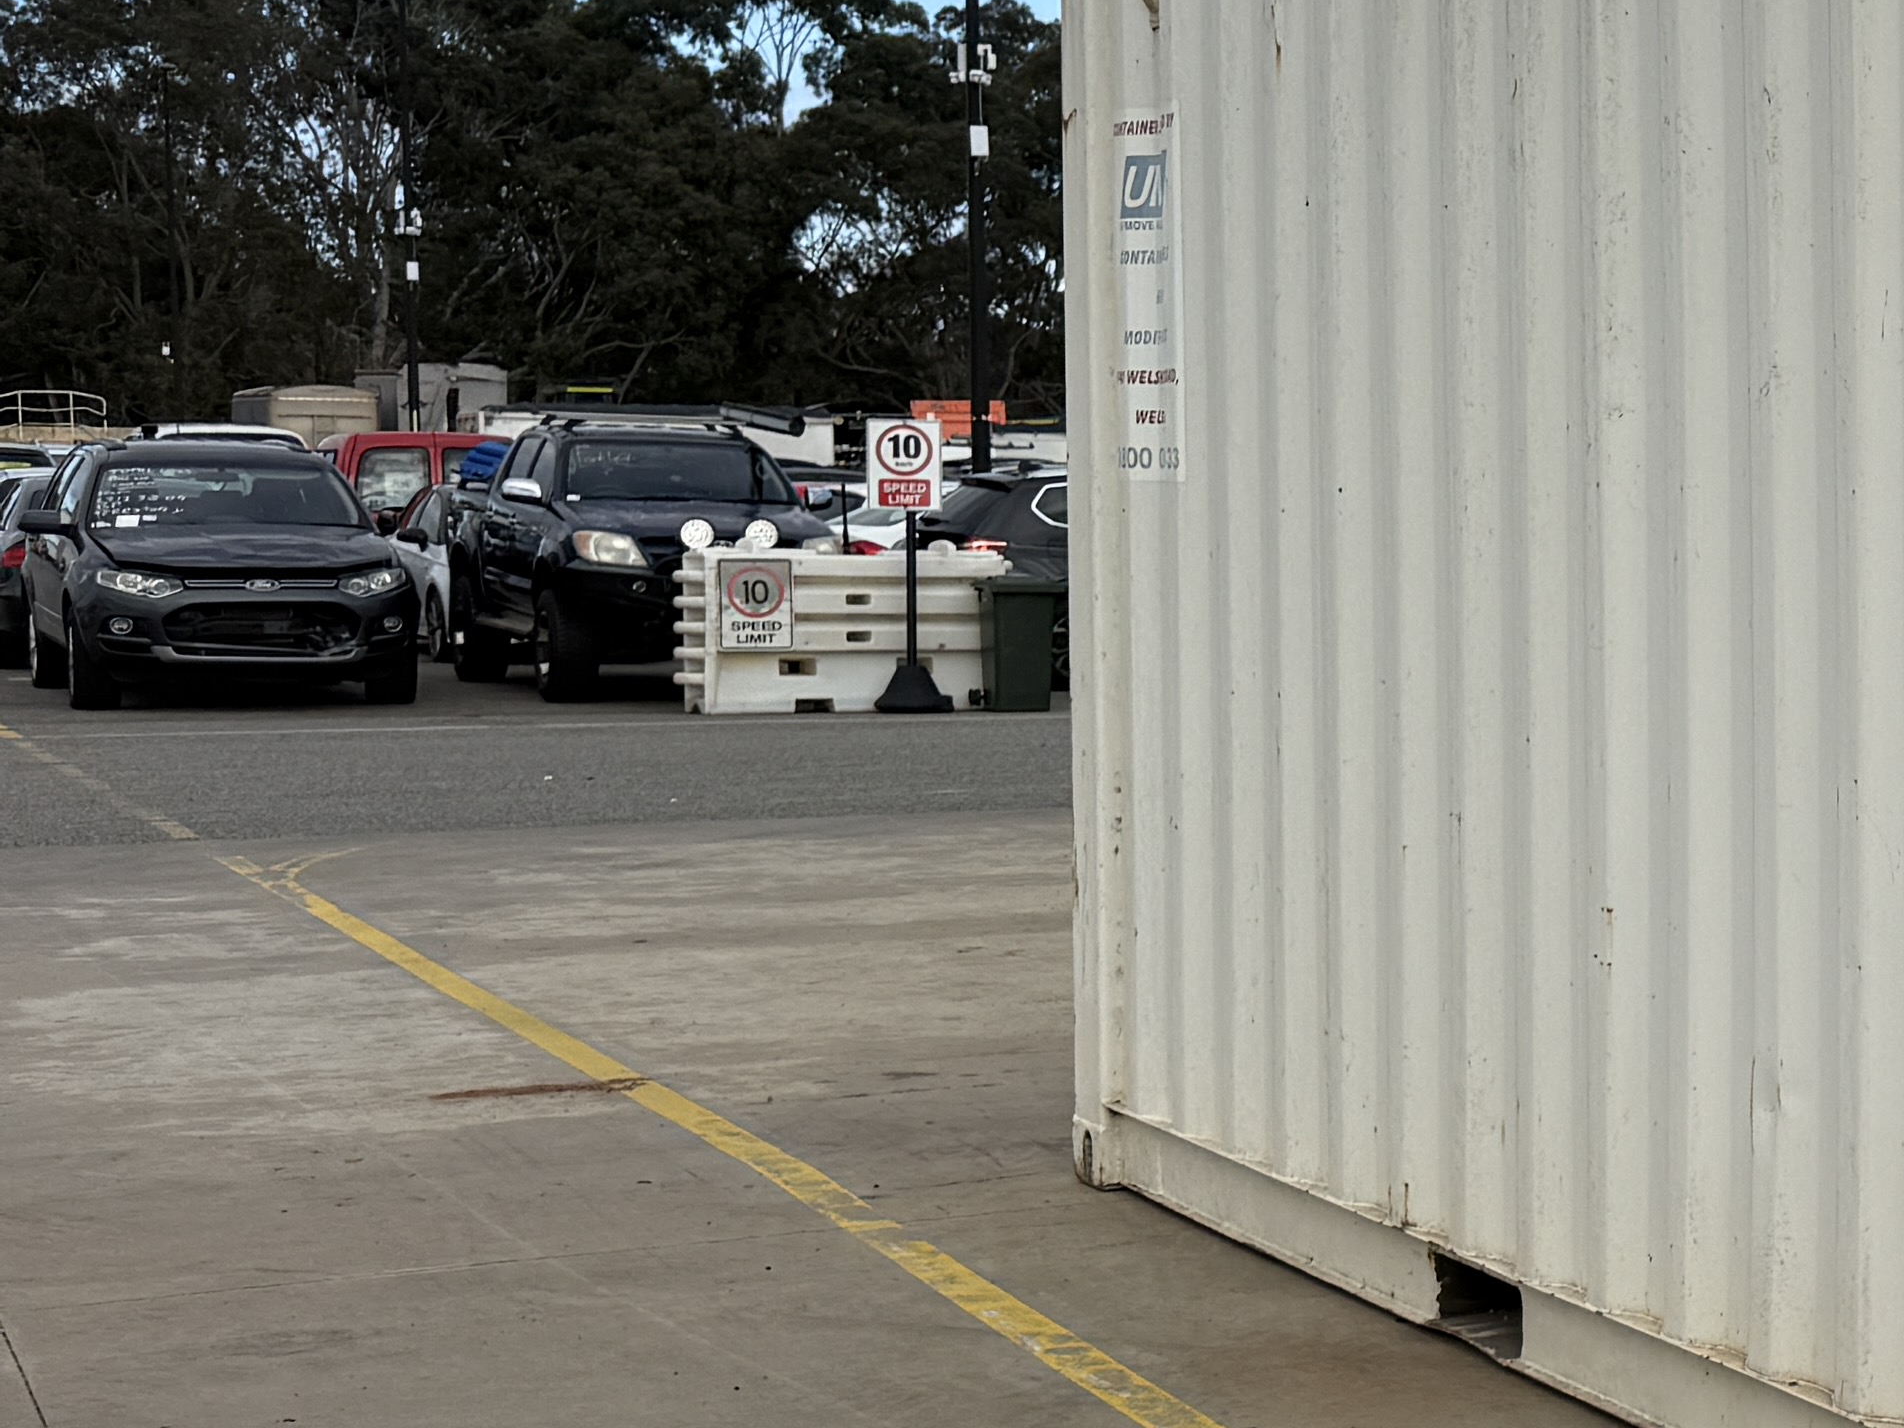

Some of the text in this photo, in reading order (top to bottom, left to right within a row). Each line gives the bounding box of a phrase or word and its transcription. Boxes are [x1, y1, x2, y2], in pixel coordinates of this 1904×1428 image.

[887, 434, 922, 459] 10
[883, 482, 927, 494] SPEED
[887, 494, 922, 505] LIMIT
[742, 579, 769, 605] 10
[731, 620, 782, 632] SPEED
[736, 633, 776, 644] LIMIT
